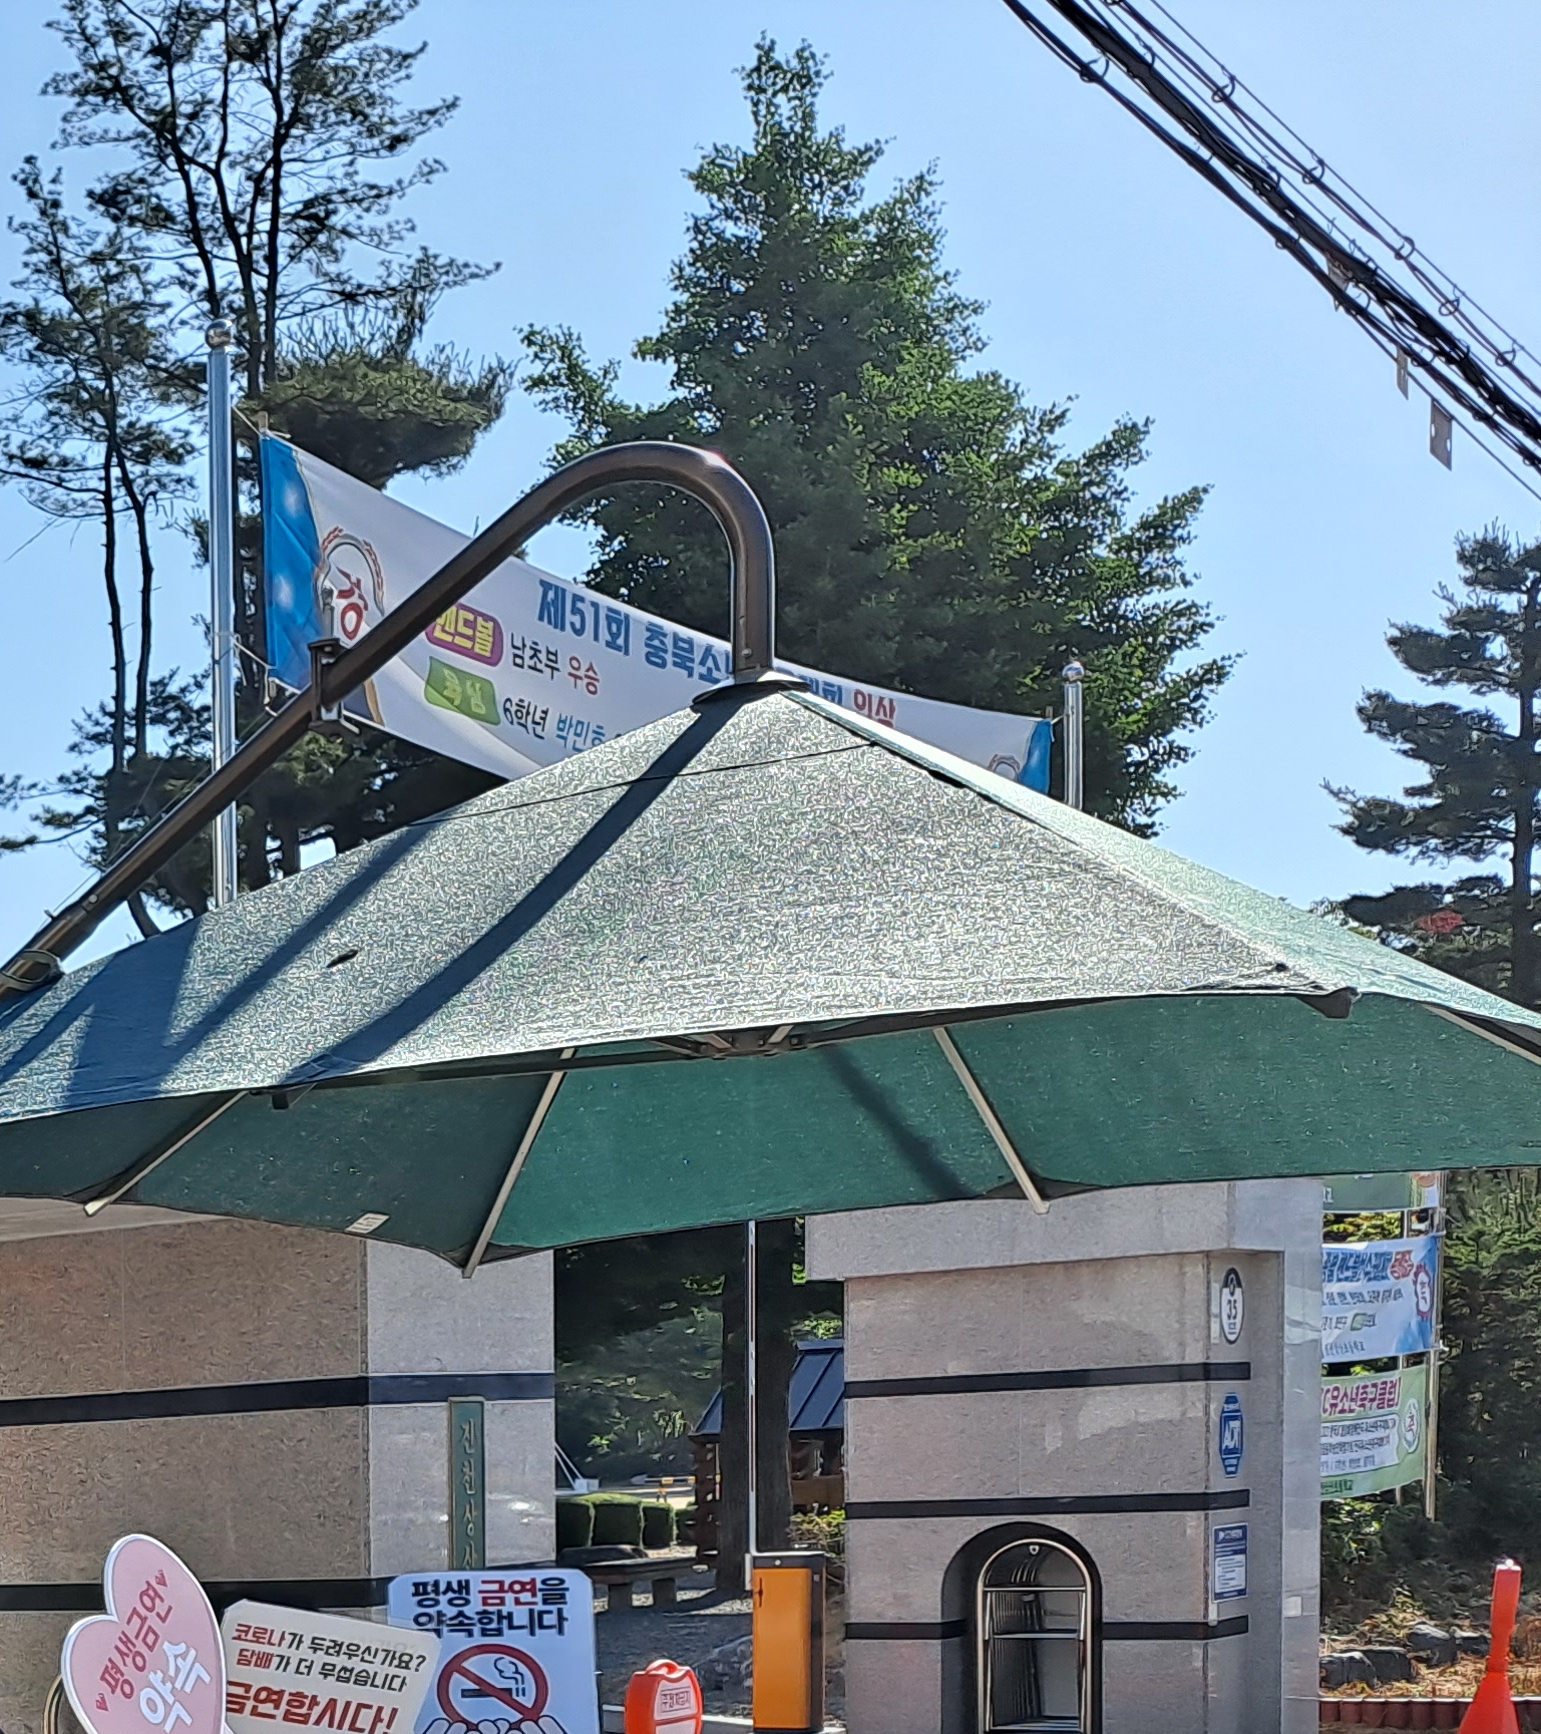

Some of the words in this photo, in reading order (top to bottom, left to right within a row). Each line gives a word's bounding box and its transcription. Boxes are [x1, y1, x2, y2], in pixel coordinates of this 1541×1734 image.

[537, 579, 631, 656] 제51회
[510, 632, 561, 681] 남초부
[567, 656, 601, 696] 우승
[503, 697, 549, 740] 6학년
[411, 1578, 472, 1609] 평생
[477, 1576, 570, 1608] 금연을
[231, 1622, 306, 1653] 코로나가
[307, 1635, 428, 1675] 두려우신가요?
[412, 1607, 569, 1640] 약속합니다
[139, 1640, 213, 1734] 약속
[235, 1647, 293, 1673] 담배가
[295, 1657, 315, 1677] 더
[318, 1661, 409, 1694] 무섭습니다
